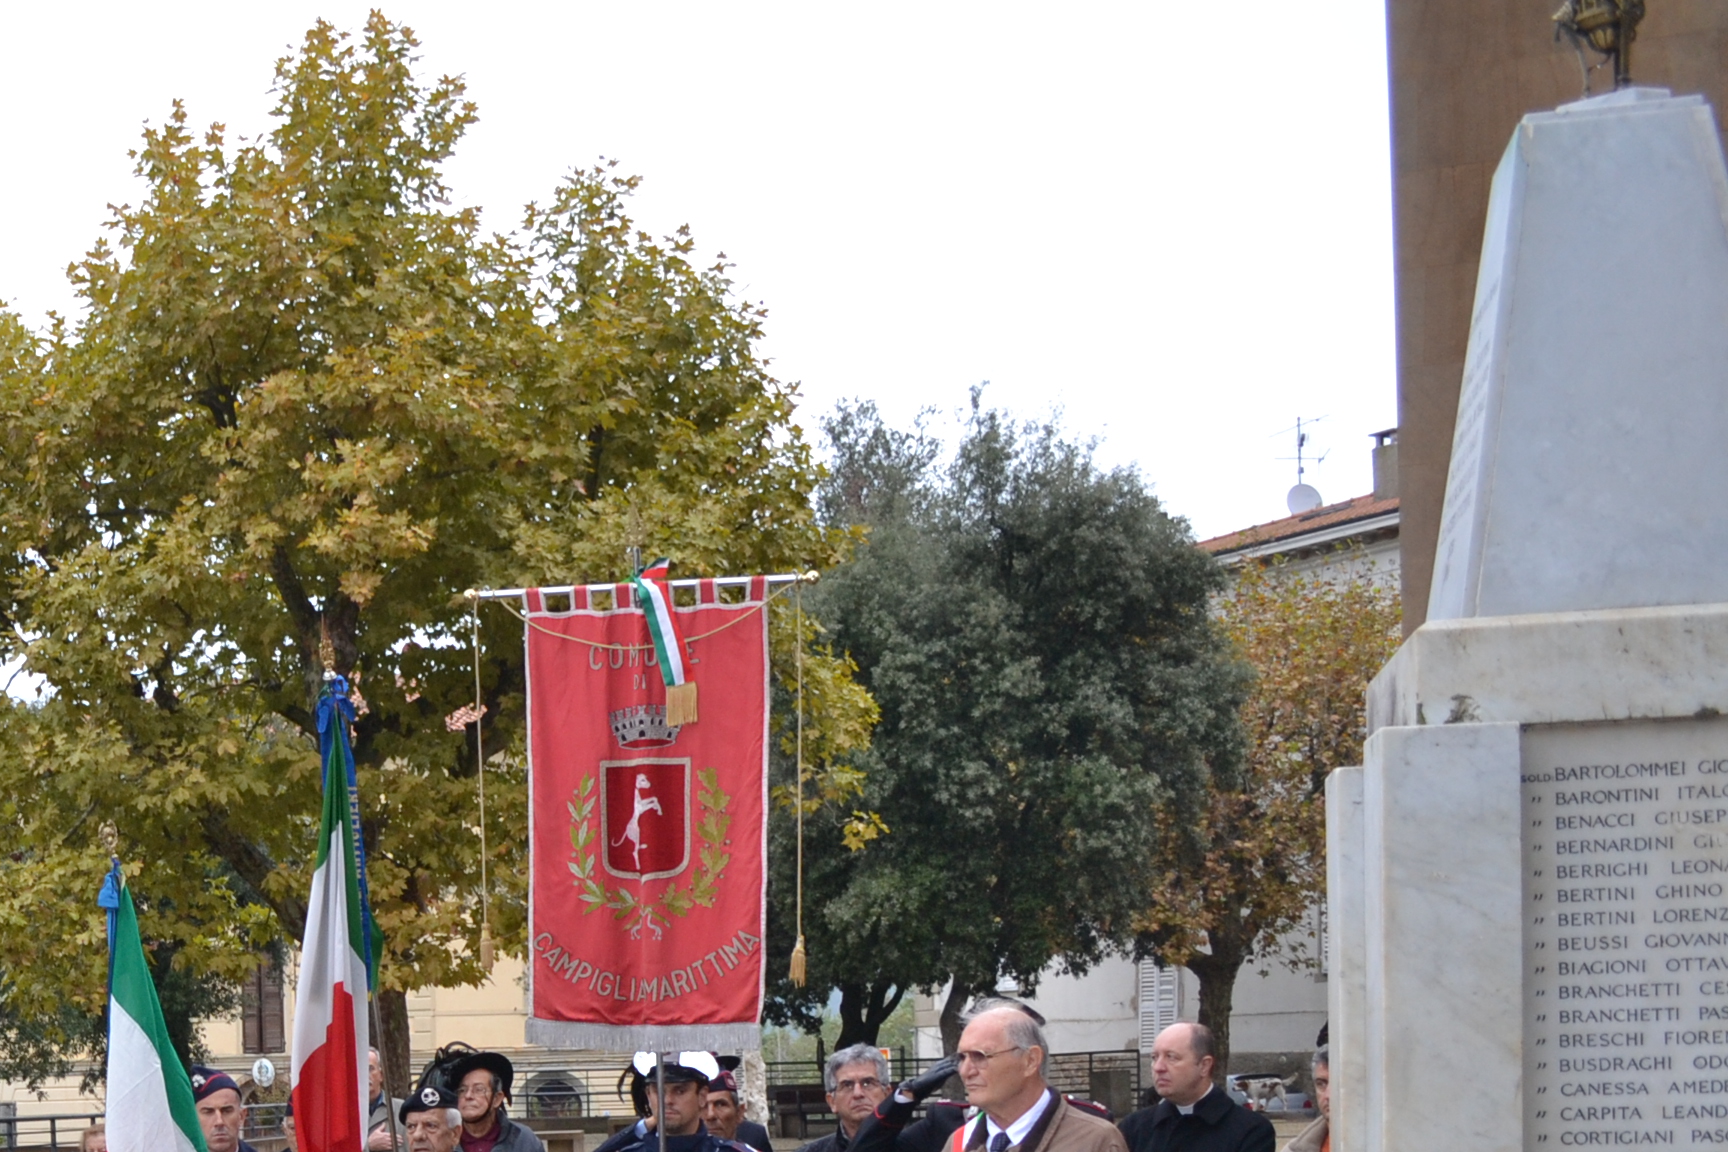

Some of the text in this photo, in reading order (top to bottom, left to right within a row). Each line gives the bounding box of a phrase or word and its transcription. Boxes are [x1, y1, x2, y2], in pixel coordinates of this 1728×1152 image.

[589, 641, 700, 671] COMUE
[634, 674, 647, 690] DI
[1555, 761, 1685, 781] BARTOLOMMEI
[1556, 787, 1659, 805] BARONTINI
[1556, 813, 1634, 830] BENACCI
[1556, 836, 1673, 854] BERNARDINI
[1557, 862, 1648, 879] BERRIGHI
[1671, 859, 1728, 875] LEON
[1557, 887, 1634, 903] BERTINI
[1655, 883, 1722, 899] GHINO
[1558, 911, 1634, 927] BERTINI
[1558, 936, 1628, 951] BEUSSI
[643, 930, 760, 1002] MARITTIMA
[1558, 960, 1646, 975] BIAGIONI
[1559, 983, 1680, 999] BRANCHETTI
[1699, 981, 1728, 995] CE
[1559, 1007, 1680, 1024] BRANCHETTI
[1559, 1032, 1644, 1048] BRESCHI
[1560, 1056, 1671, 1072] BUSDRAGHI
[1560, 1082, 1649, 1097] CANESSA
[1560, 1107, 1642, 1121] CARPITA
[1561, 1130, 1673, 1145] CORTIGIANI
[1692, 1129, 1728, 1143] PAS
